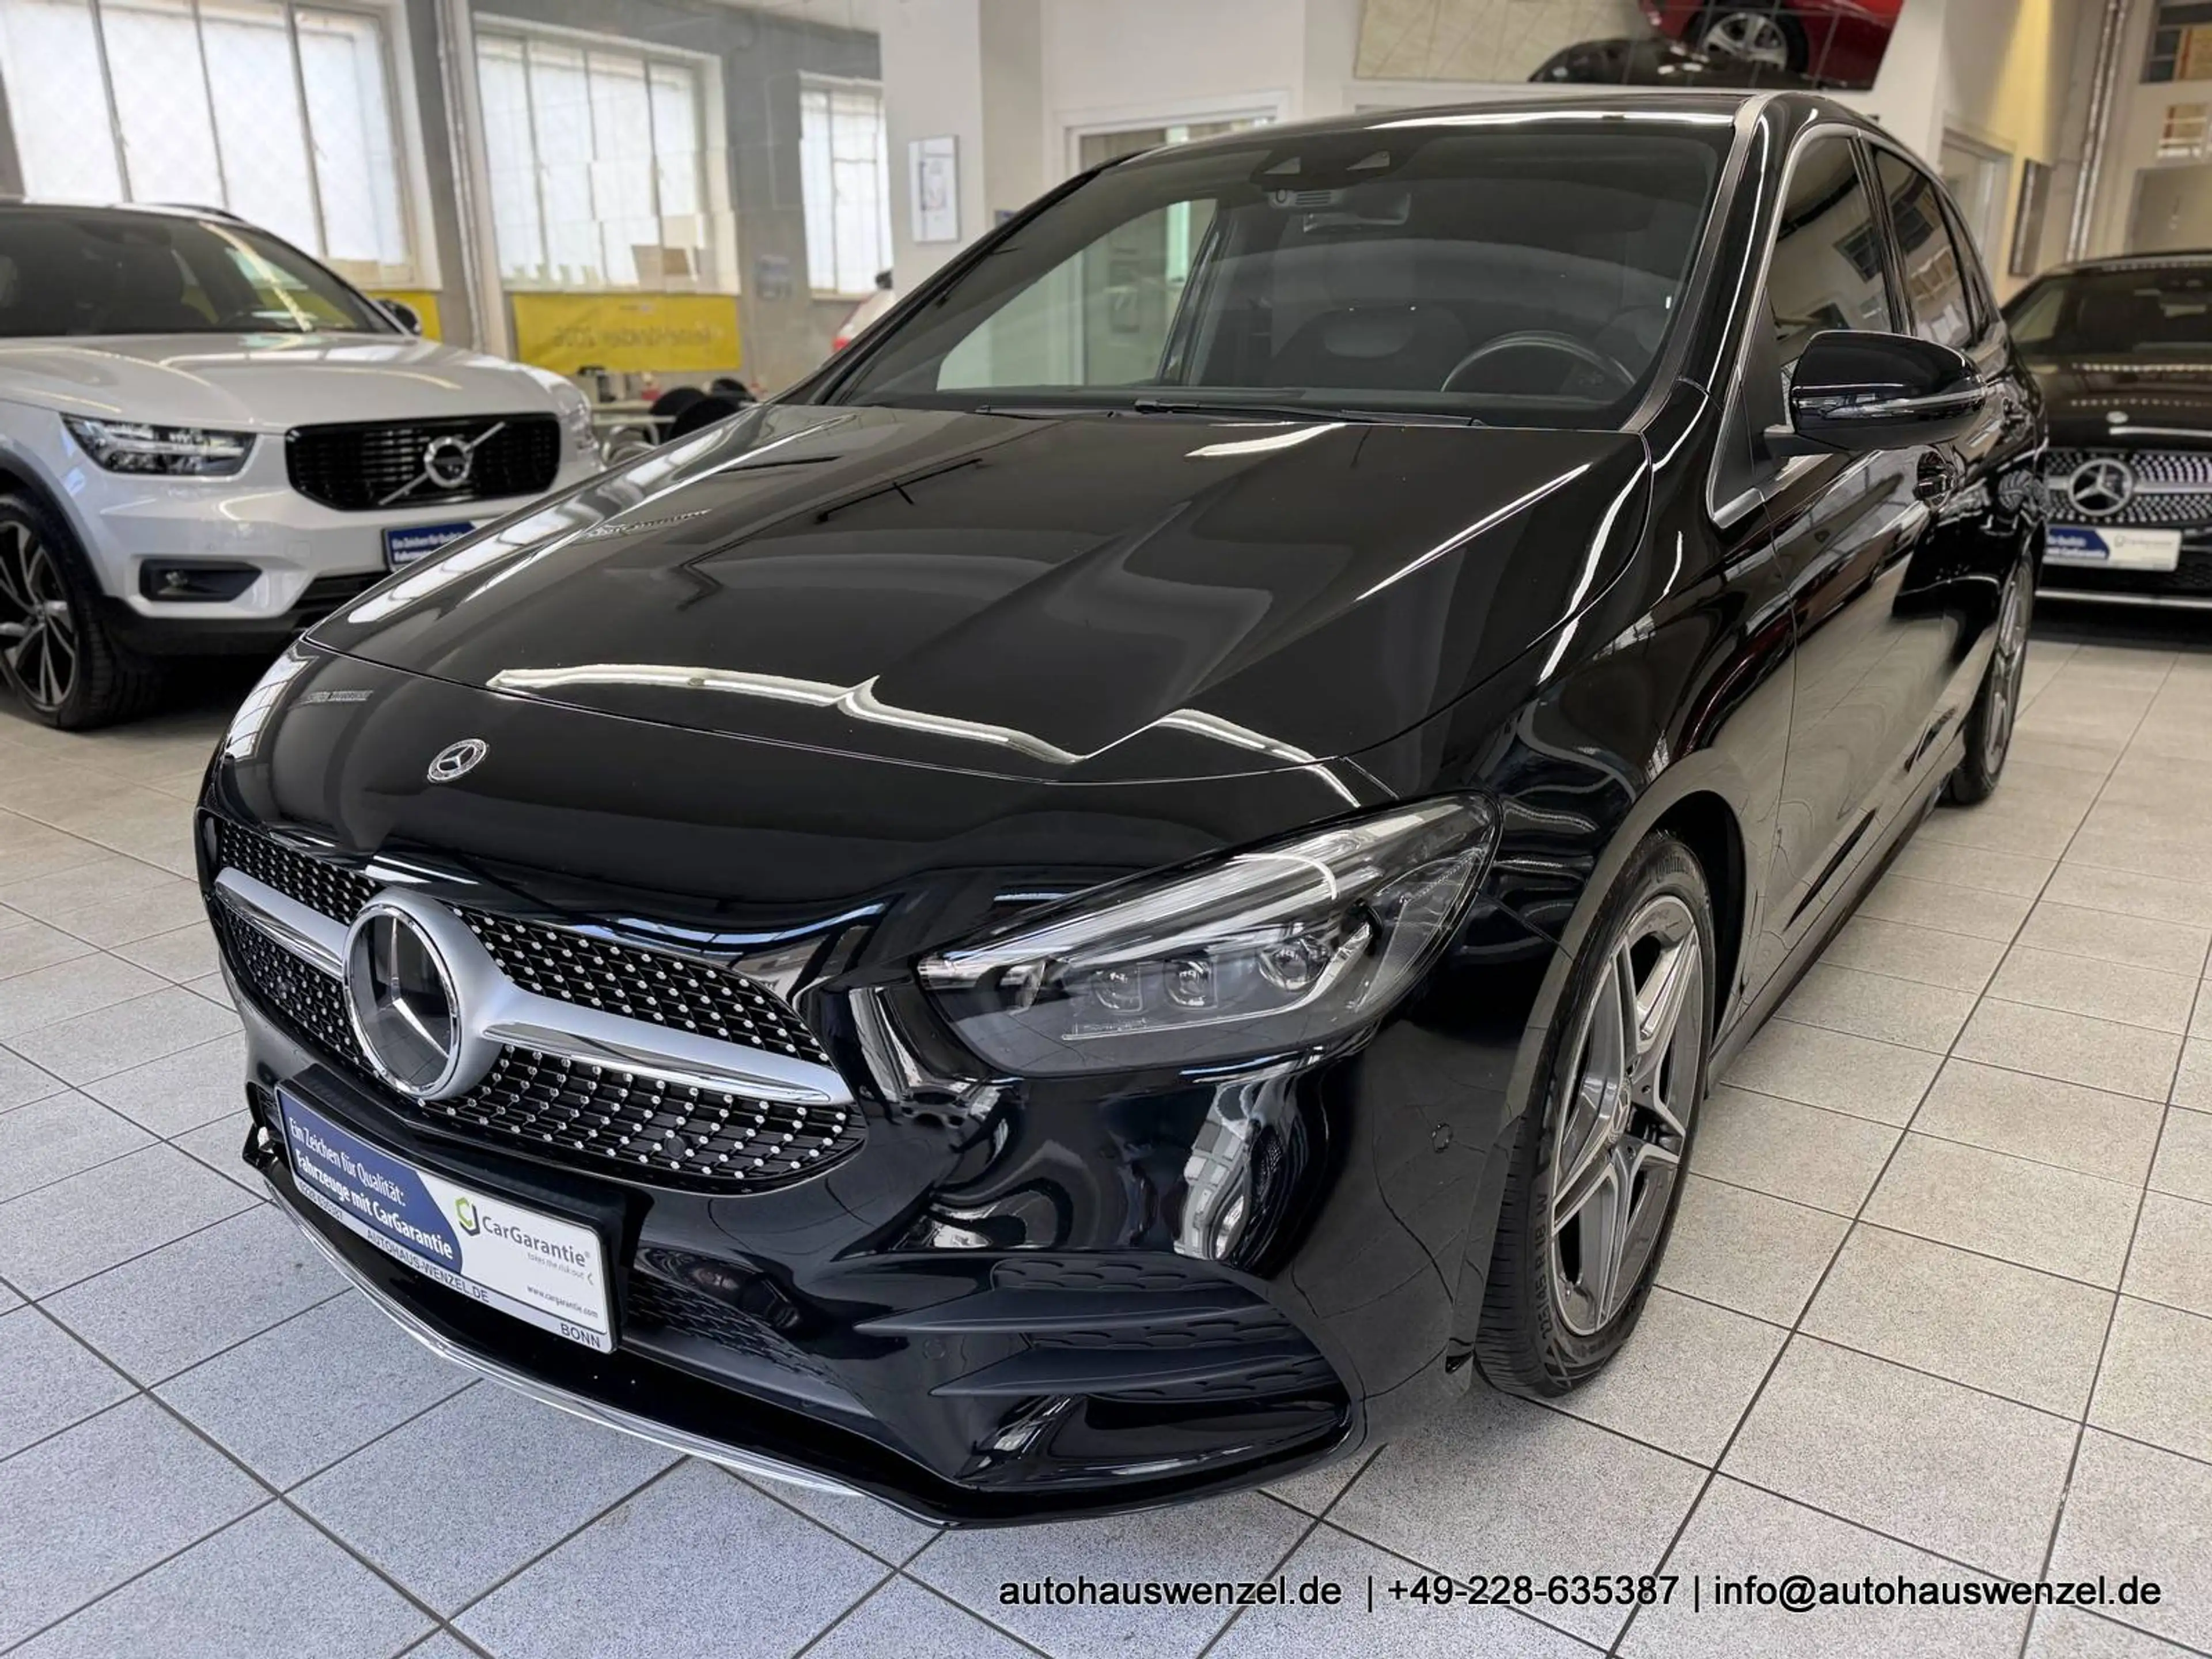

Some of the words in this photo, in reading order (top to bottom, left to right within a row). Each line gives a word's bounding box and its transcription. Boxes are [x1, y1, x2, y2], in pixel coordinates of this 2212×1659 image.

[289, 1116, 304, 1143] Ein
[302, 1127, 342, 1169] Zeichen
[340, 1151, 357, 1178] für
[356, 1162, 406, 1207] Qualität:
[294, 1147, 351, 1203] Fahrzeuge
[350, 1190, 373, 1216] mit
[372, 1200, 454, 1260] CarGarantie
[366, 1228, 490, 1304] AUTOHAUS-WENZEL.DE
[560, 1323, 601, 1349] BONN
